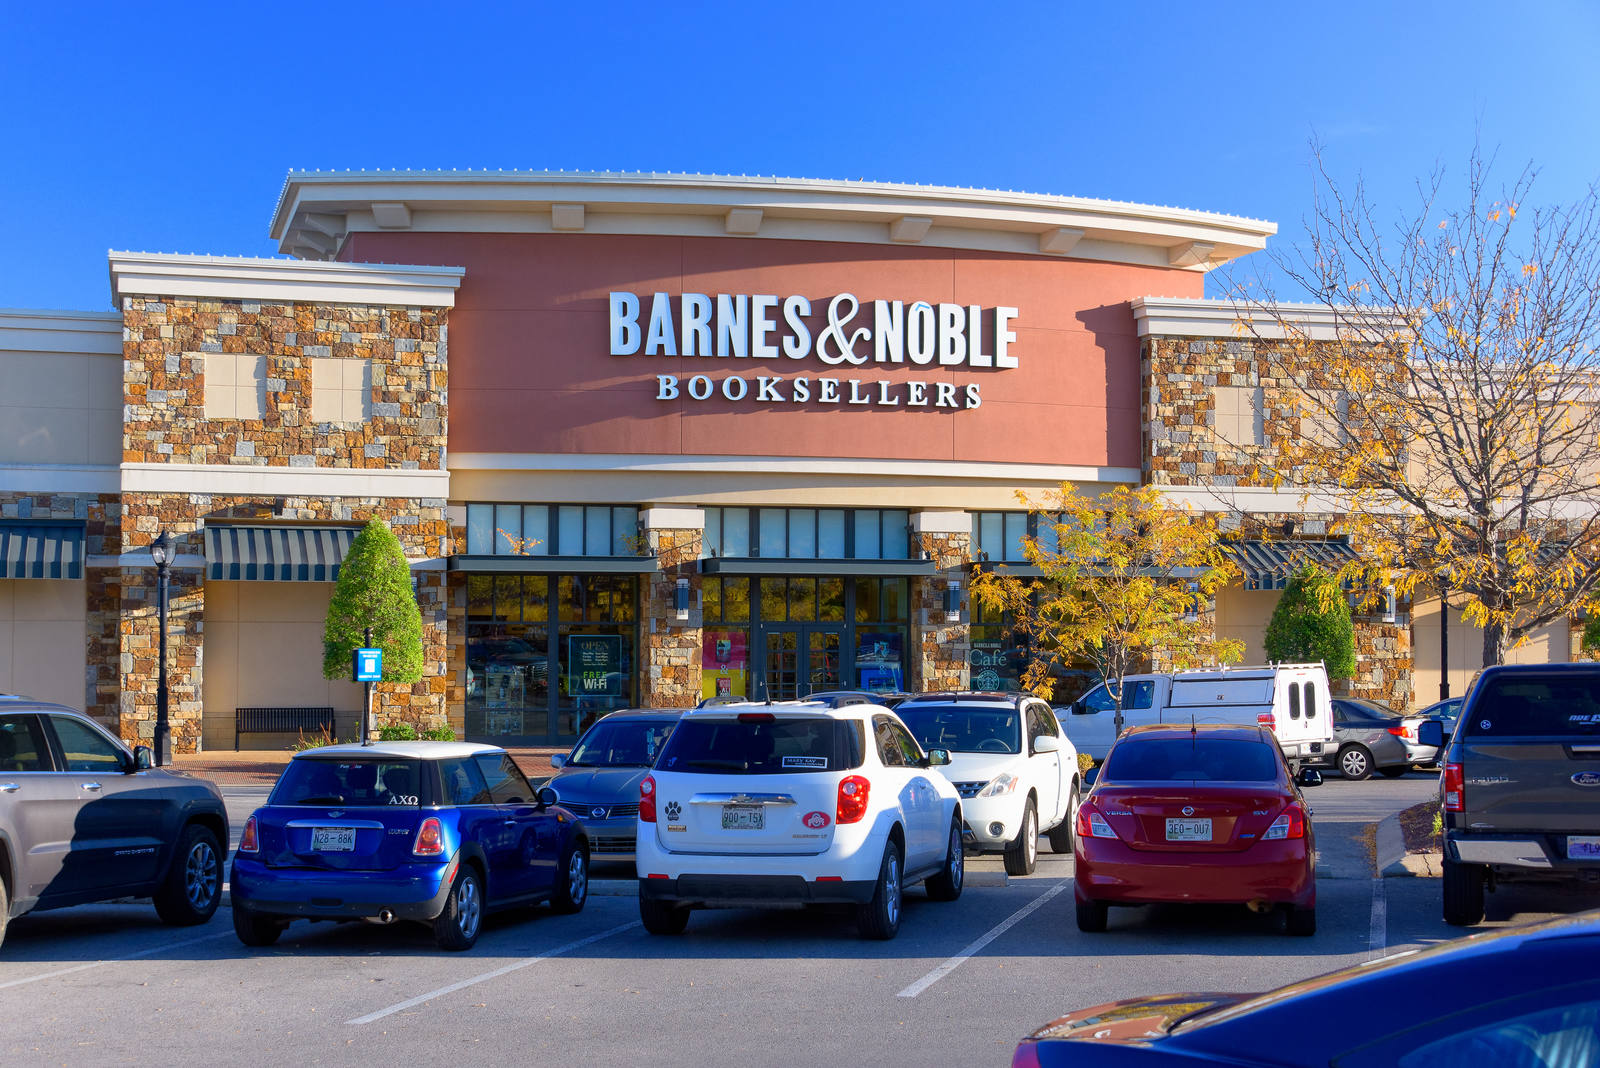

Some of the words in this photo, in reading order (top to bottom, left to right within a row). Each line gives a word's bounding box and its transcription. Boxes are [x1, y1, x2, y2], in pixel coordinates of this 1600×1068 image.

[655, 374, 983, 409] BOOKSELLERS
[969, 649, 1007, 667] Café
[583, 671, 608, 679] FREE
[583, 678, 608, 690] Wi-Fi
